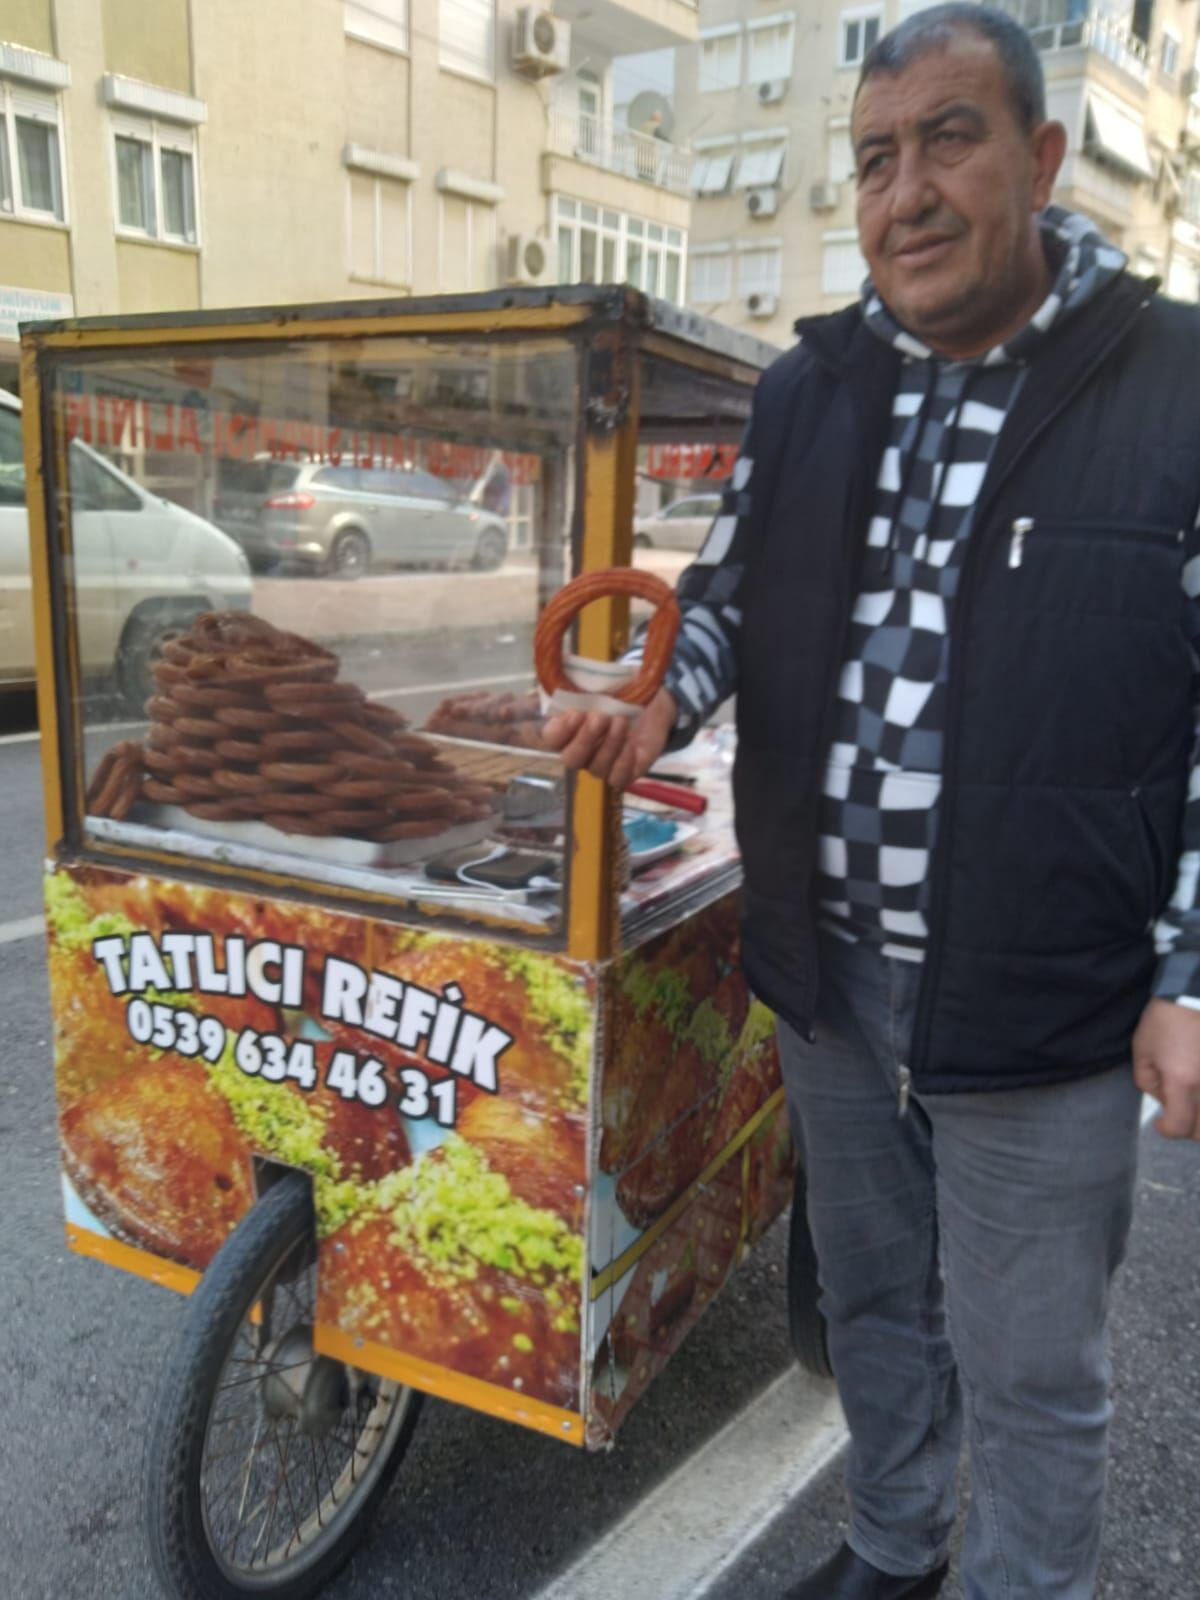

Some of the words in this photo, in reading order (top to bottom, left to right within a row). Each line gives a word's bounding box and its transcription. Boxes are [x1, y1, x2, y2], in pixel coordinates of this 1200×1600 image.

[93, 930, 307, 1007] TATLICI
[321, 955, 515, 1094] REFİK
[126, 996, 227, 1063] 0539
[234, 1027, 317, 1091] 634
[326, 1049, 387, 1109] 46
[399, 1067, 458, 1127] 31
